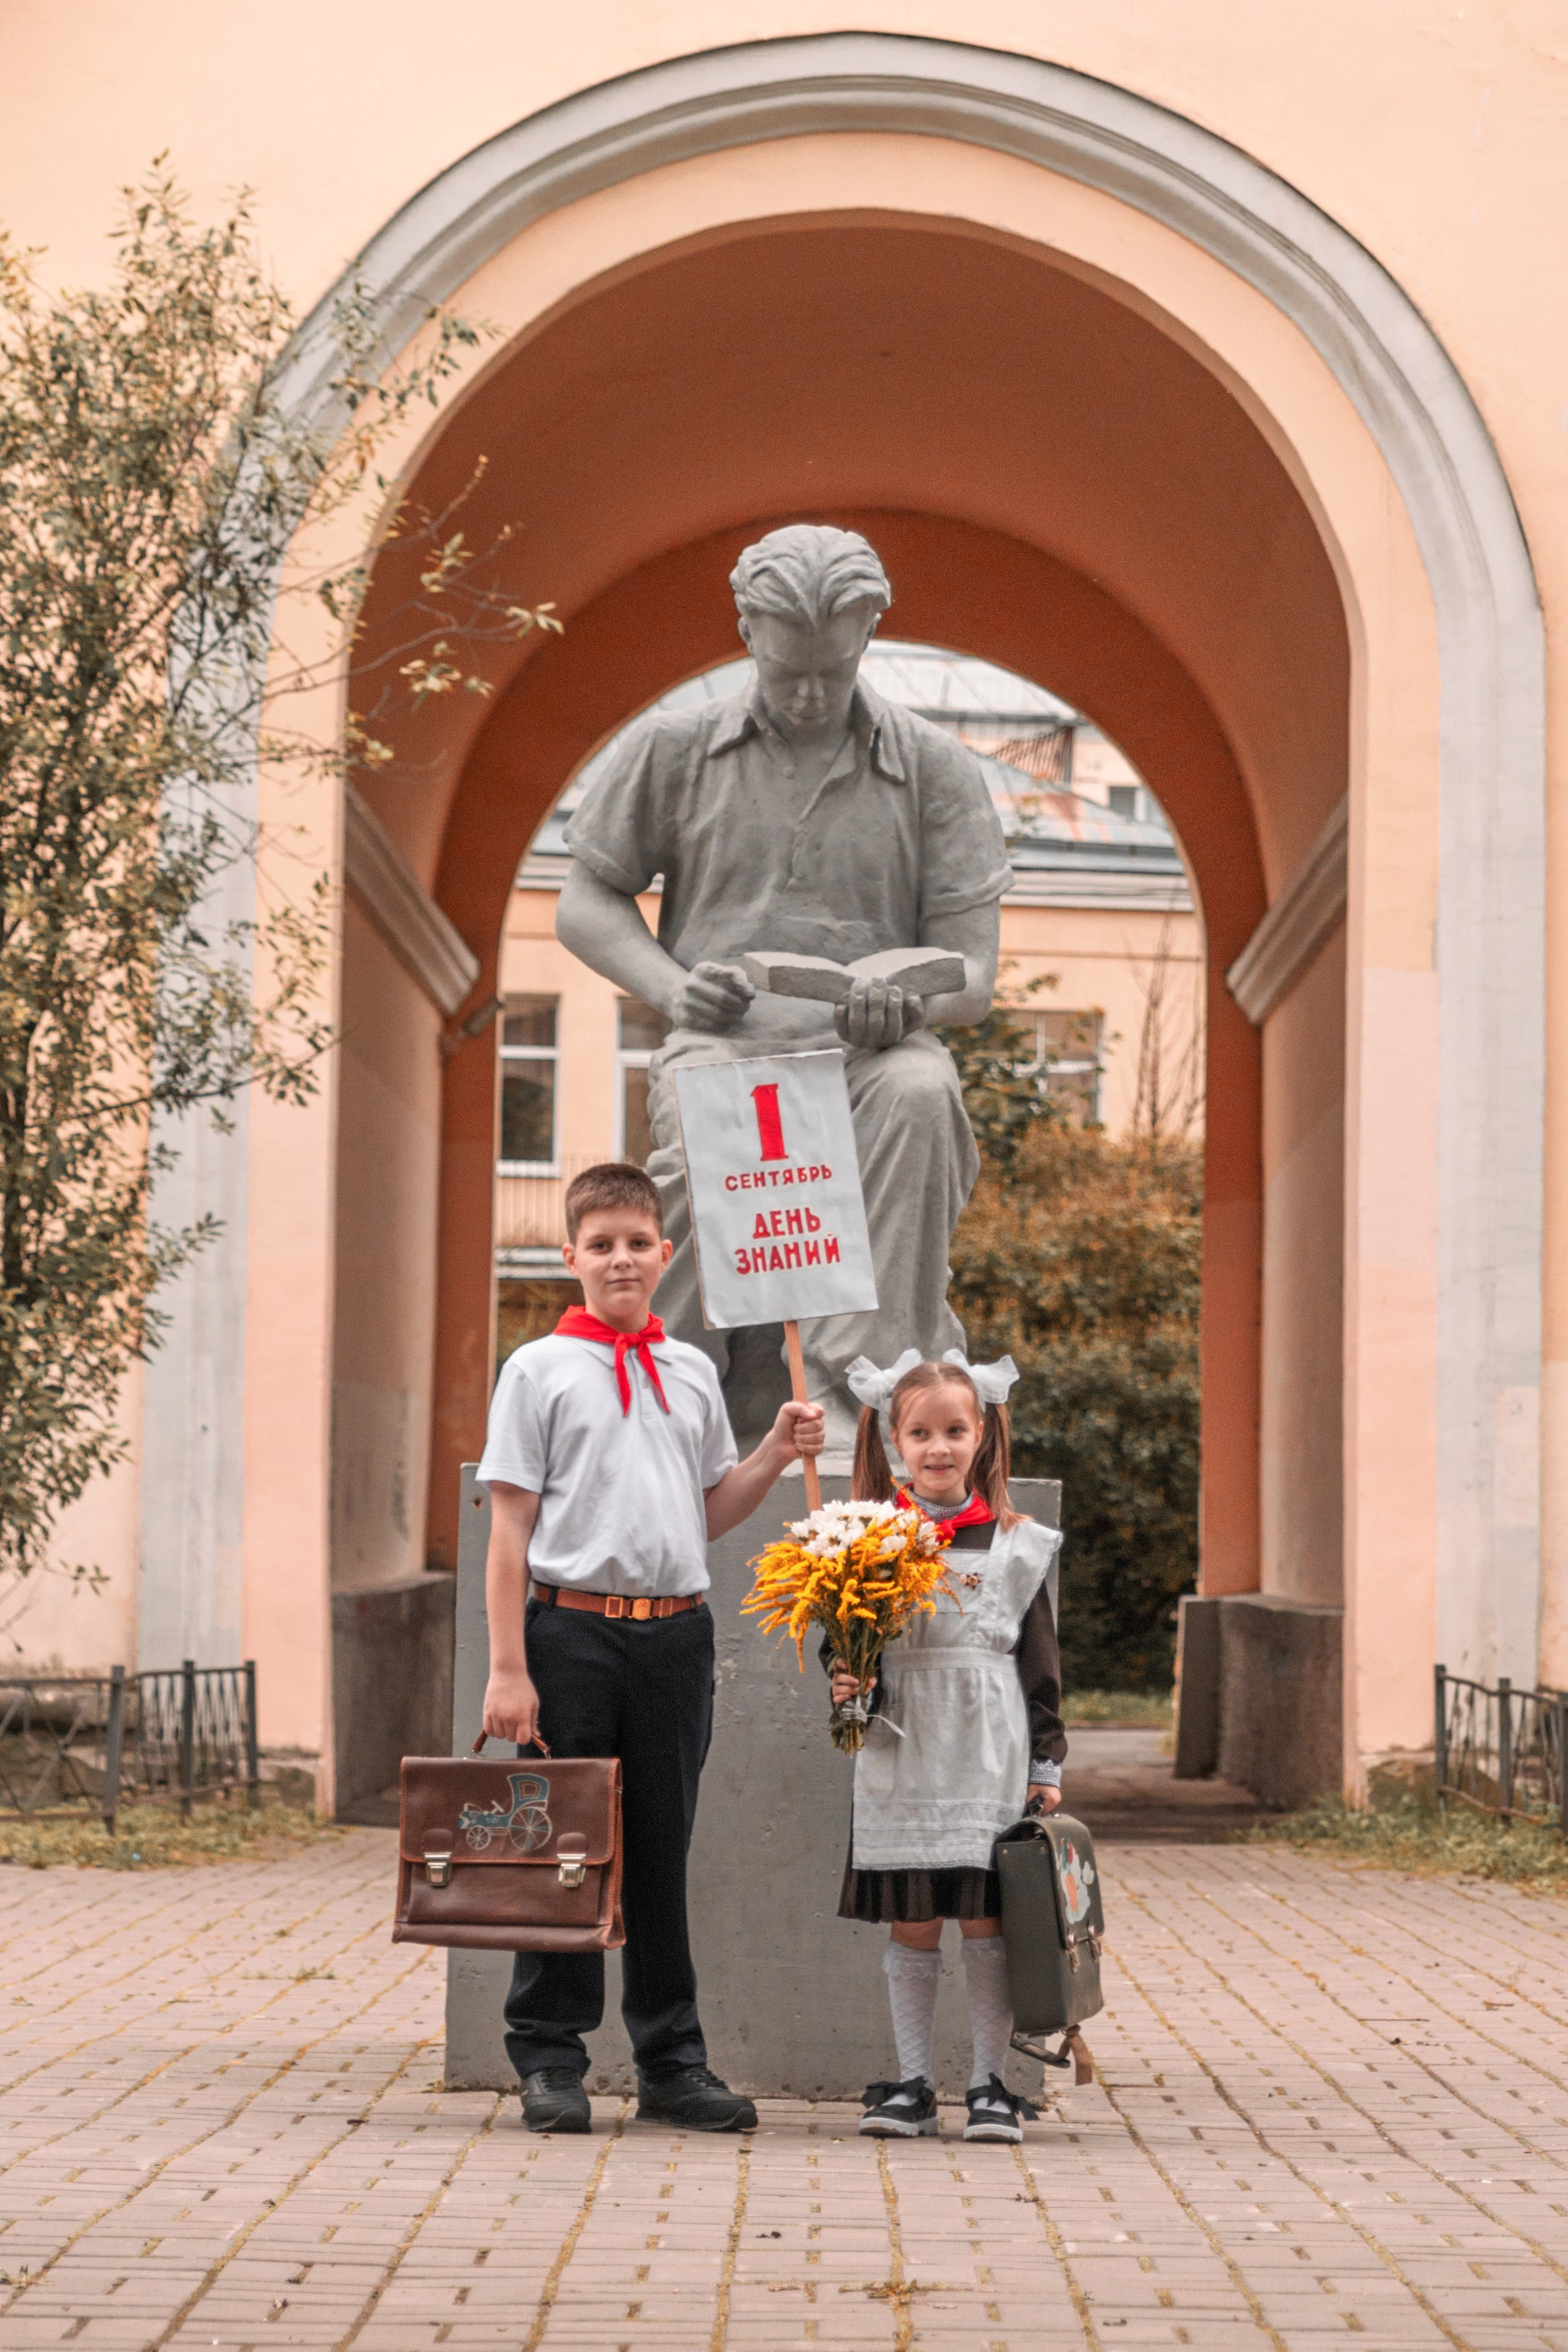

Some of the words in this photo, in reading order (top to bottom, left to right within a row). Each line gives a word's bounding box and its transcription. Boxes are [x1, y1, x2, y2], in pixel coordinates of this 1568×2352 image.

[751, 1083, 789, 1161] 1
[725, 1165, 832, 1191] СЕНТЯБРЬ
[752, 1207, 821, 1239] ДЕНЬ
[735, 1234, 841, 1275] ЗНАНИЙ
